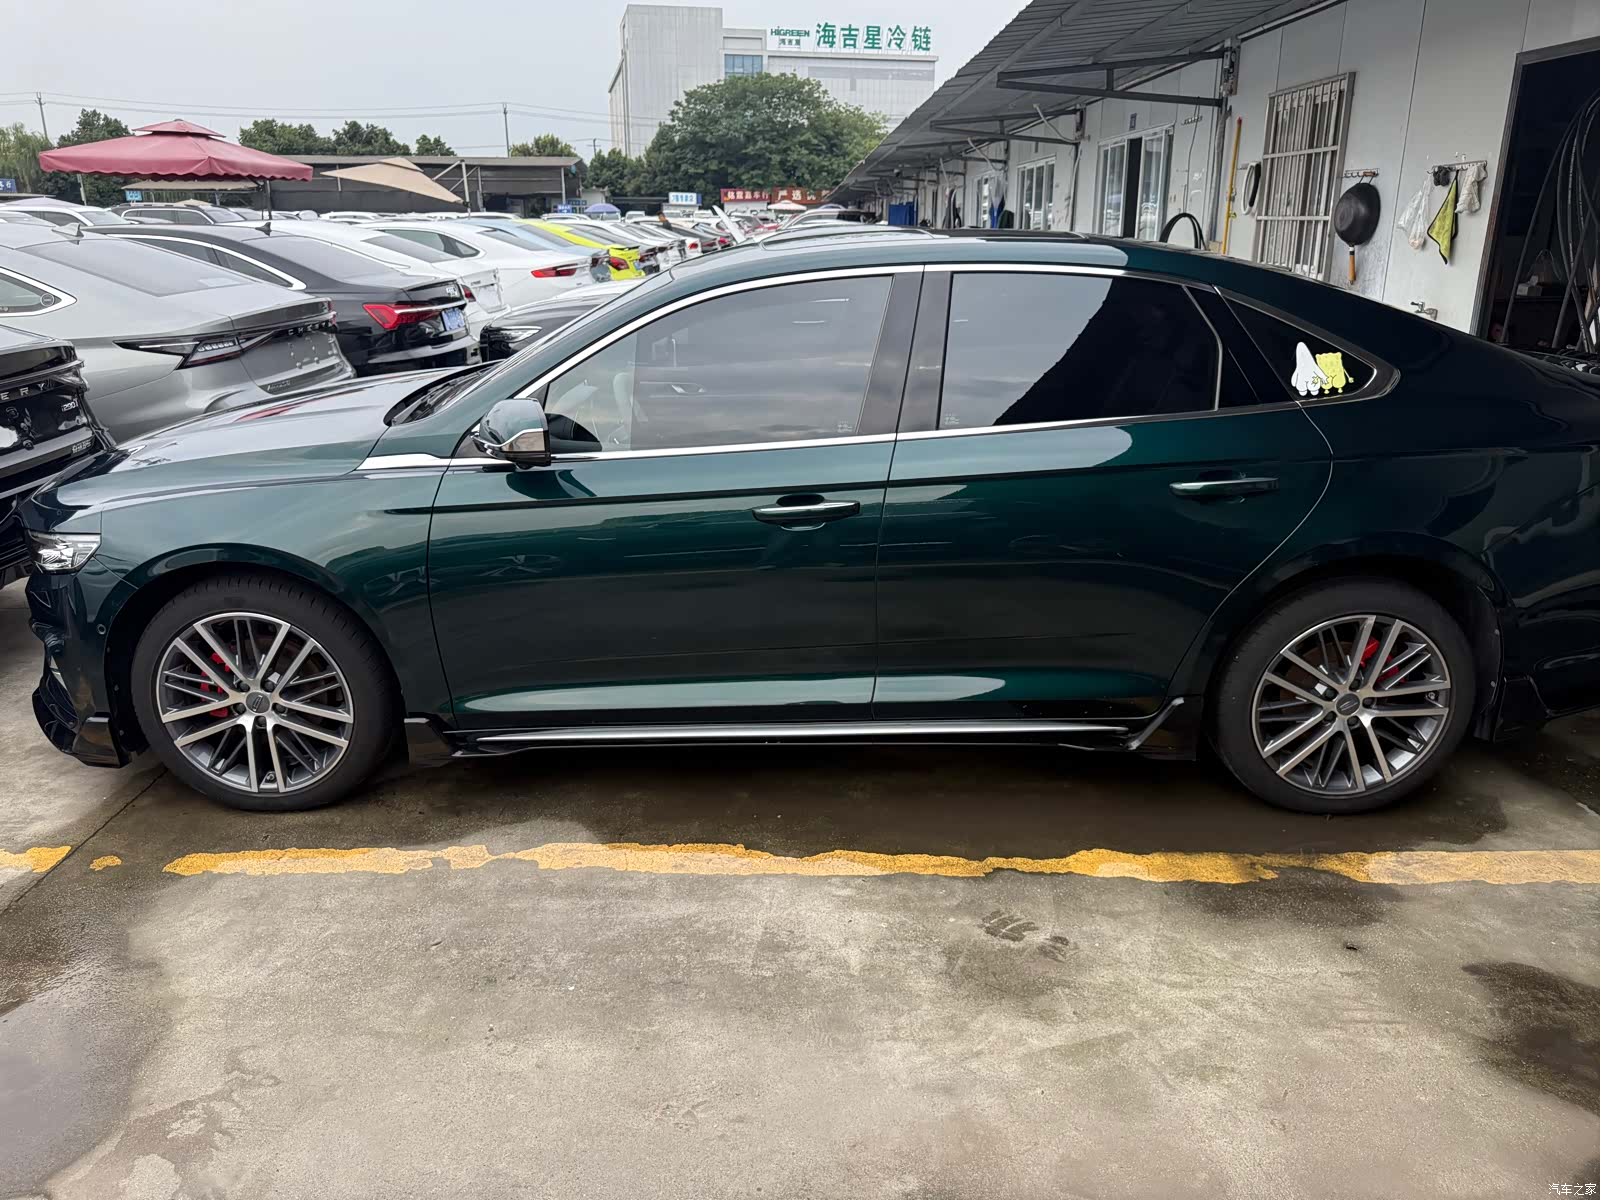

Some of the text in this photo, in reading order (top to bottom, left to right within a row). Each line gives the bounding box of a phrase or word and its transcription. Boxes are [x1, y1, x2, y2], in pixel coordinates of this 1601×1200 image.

[816, 22, 931, 51] 海吉星冷链
